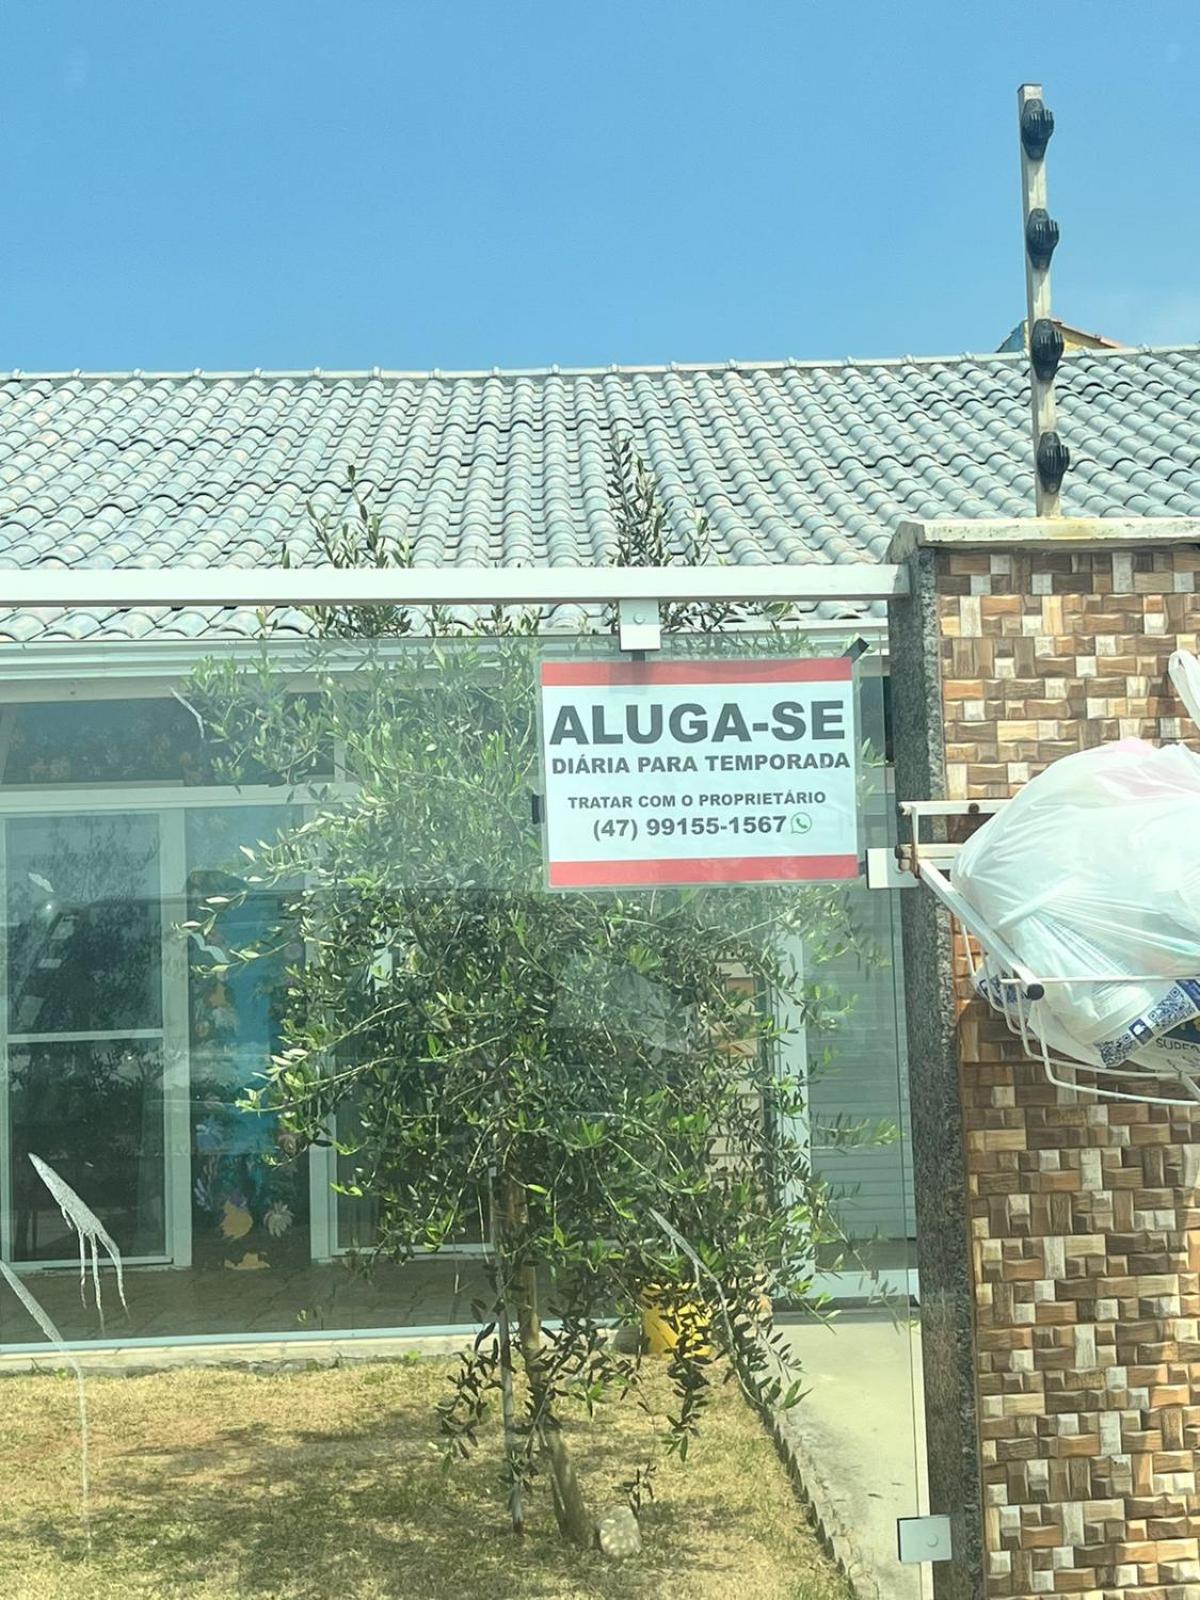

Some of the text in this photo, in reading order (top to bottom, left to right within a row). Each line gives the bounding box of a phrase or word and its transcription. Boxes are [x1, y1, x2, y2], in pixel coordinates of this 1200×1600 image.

[549, 701, 845, 745] ALUGA-SE
[552, 752, 851, 774] DIÁRIA PARA TEMPORADA
[568, 790, 827, 809] TRATAR COM O PROPRIETÁRIO
[593, 816, 787, 841] (47) 99155-1567
